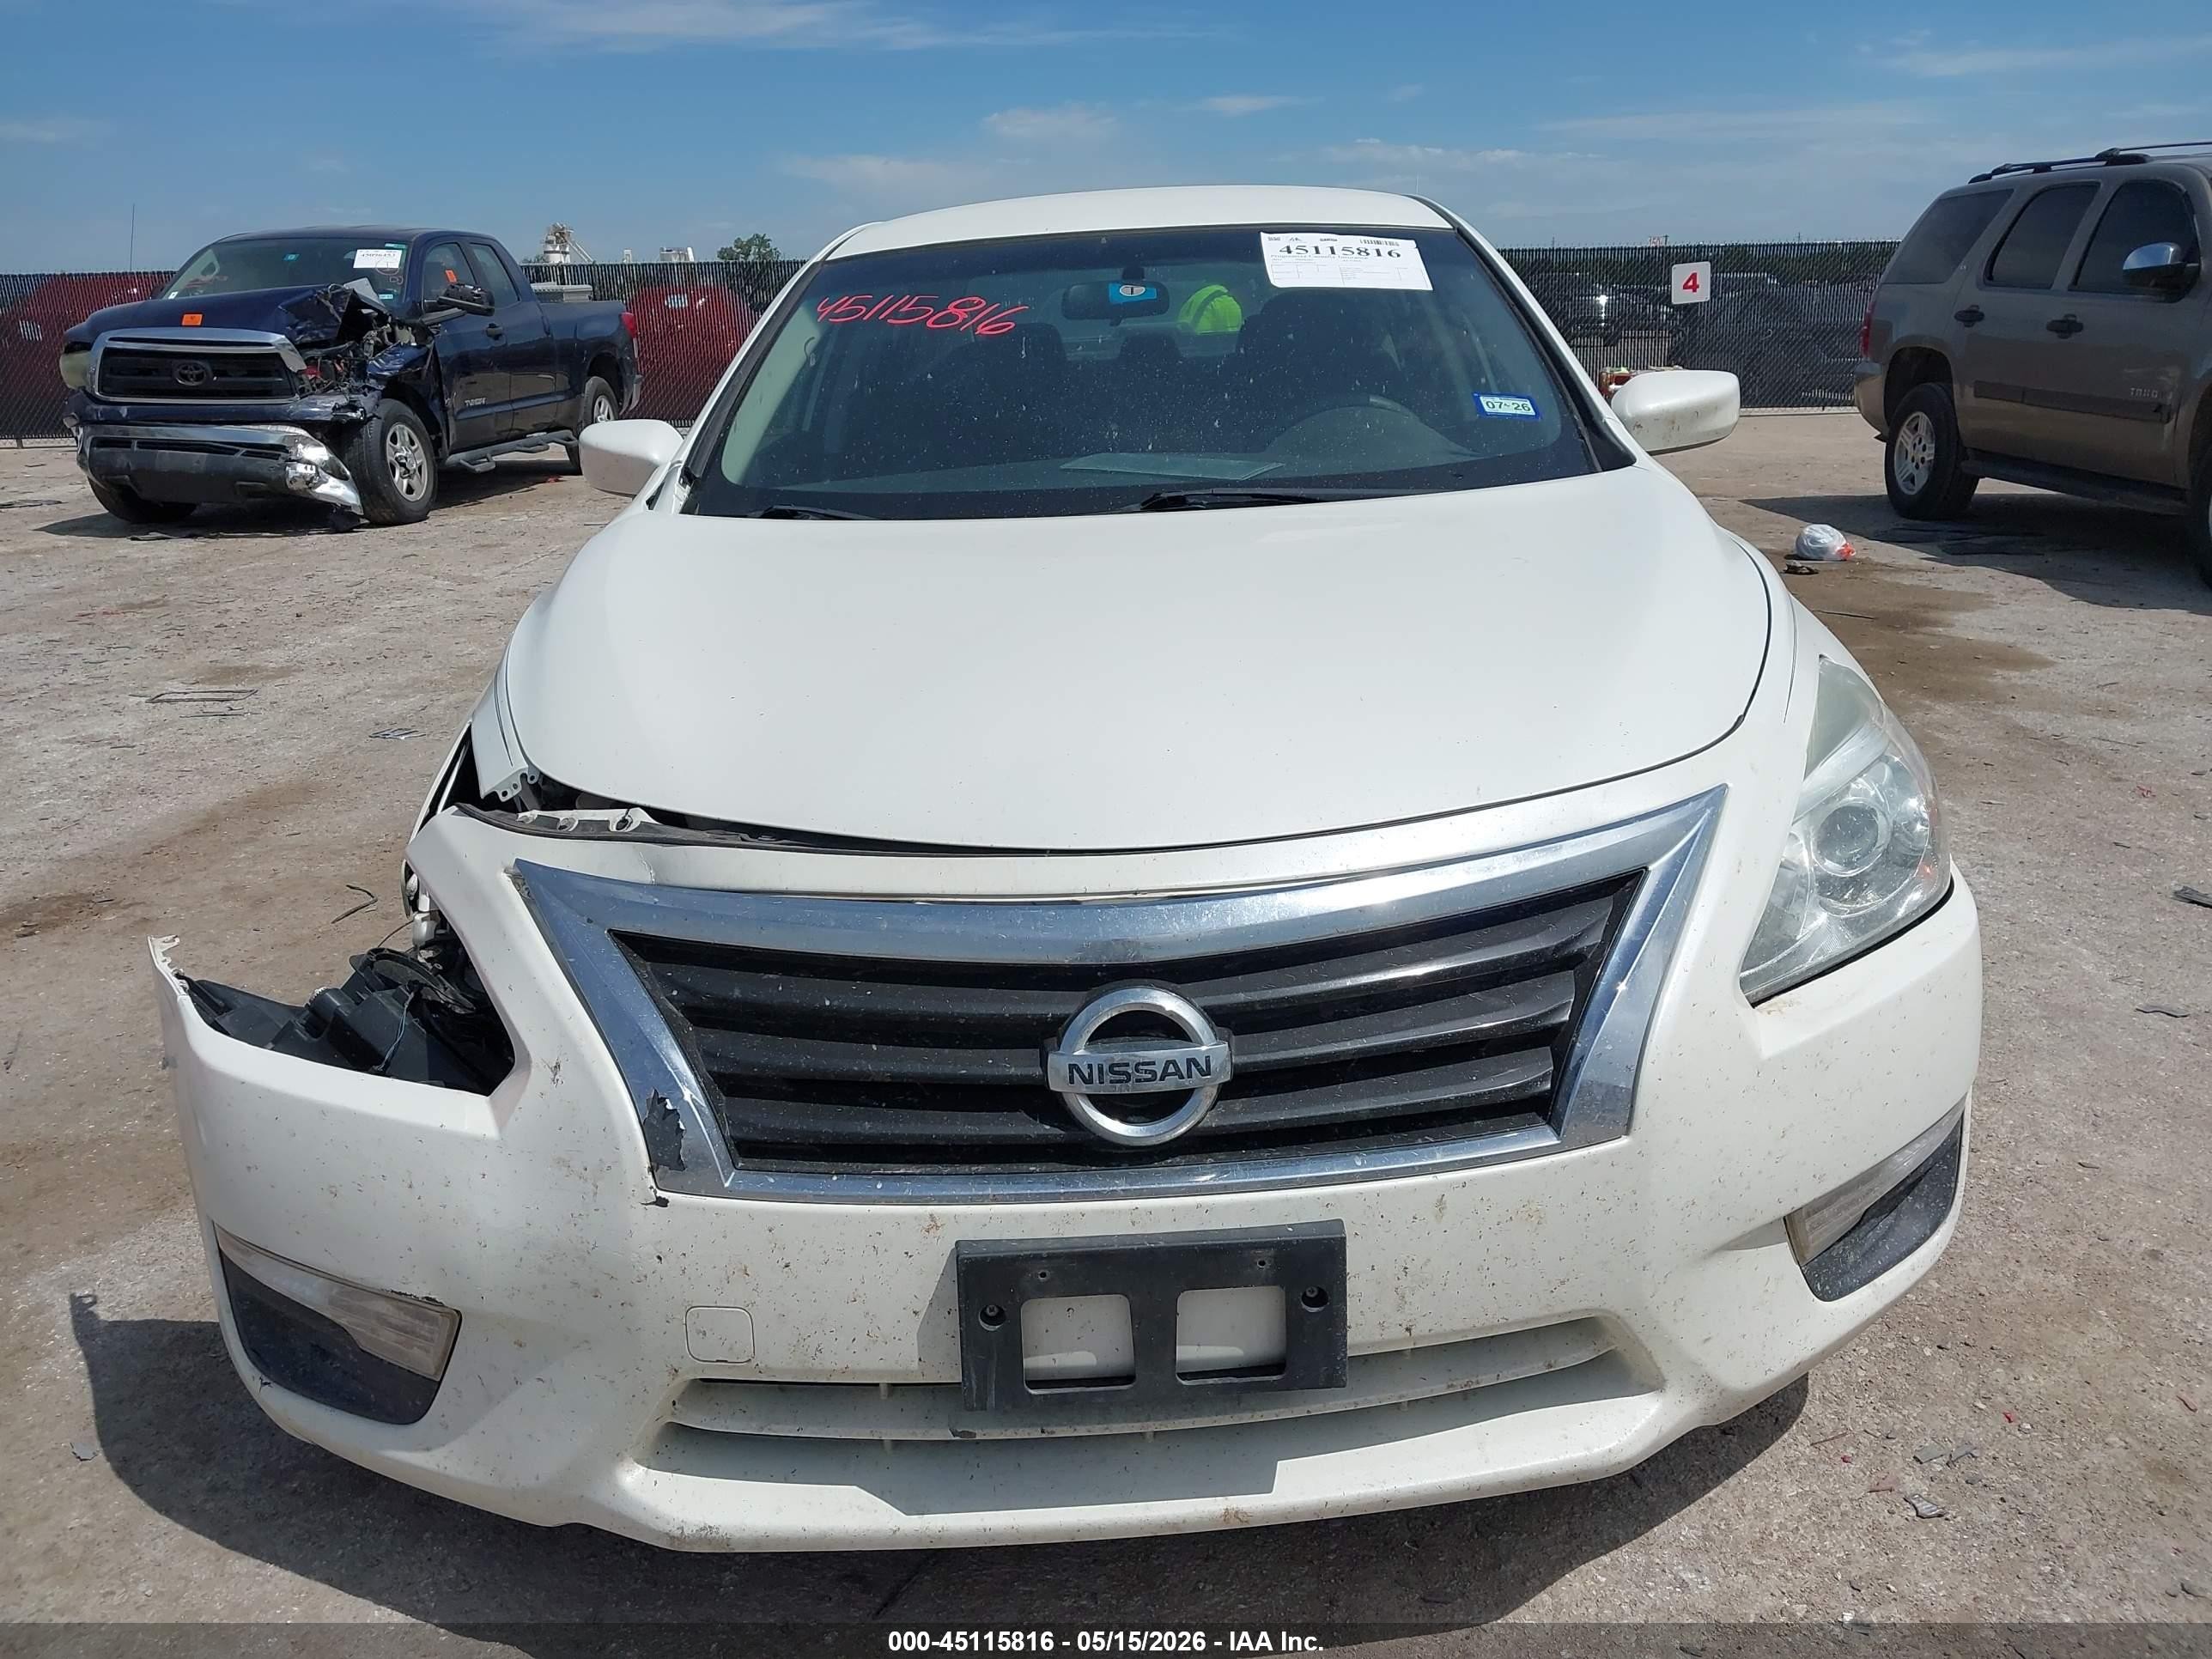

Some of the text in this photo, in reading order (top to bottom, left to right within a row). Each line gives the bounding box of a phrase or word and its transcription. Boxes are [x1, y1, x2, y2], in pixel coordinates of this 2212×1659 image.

[1279, 245, 1402, 258] 45115816
[1682, 271, 1700, 293] 4
[817, 295, 1030, 335] 45115816
[1067, 1055, 1212, 1085] NISSAN
